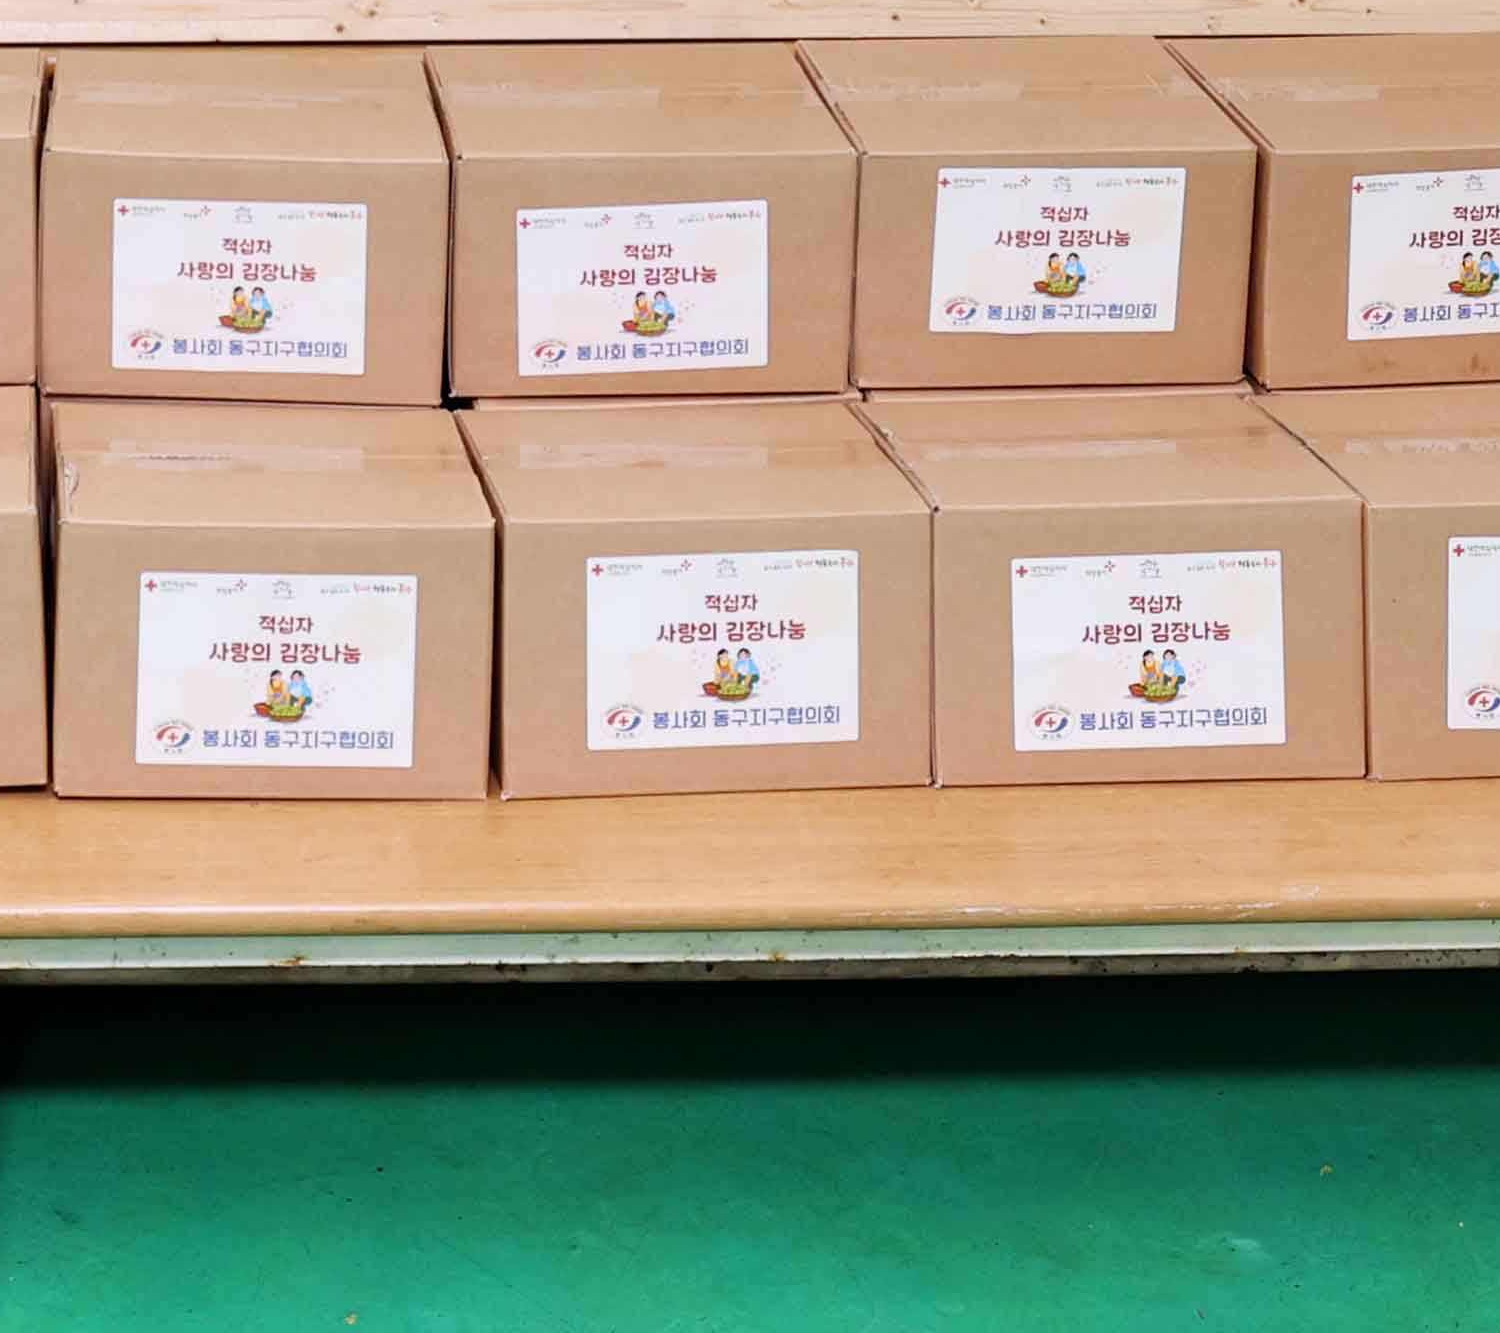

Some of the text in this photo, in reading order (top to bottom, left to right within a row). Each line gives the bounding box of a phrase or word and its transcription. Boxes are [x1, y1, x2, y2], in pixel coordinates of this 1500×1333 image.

[1408, 228, 1464, 251] 사랑의
[622, 242, 674, 261] 적십자
[578, 264, 718, 289] 사랑의 김장나눔
[1402, 304, 1451, 324] 봉사회
[575, 337, 749, 362] 봉사회 동구지구협의회
[1127, 593, 1183, 615] 적십자
[257, 614, 314, 635] 적십자
[1080, 619, 1232, 646] 사랑의 김장나눔
[207, 641, 363, 665] 사랑의 김장나눔
[1078, 705, 1268, 733] 봉사회 동구지구협의회
[201, 729, 395, 750] 봉사회 동구지구협의회
